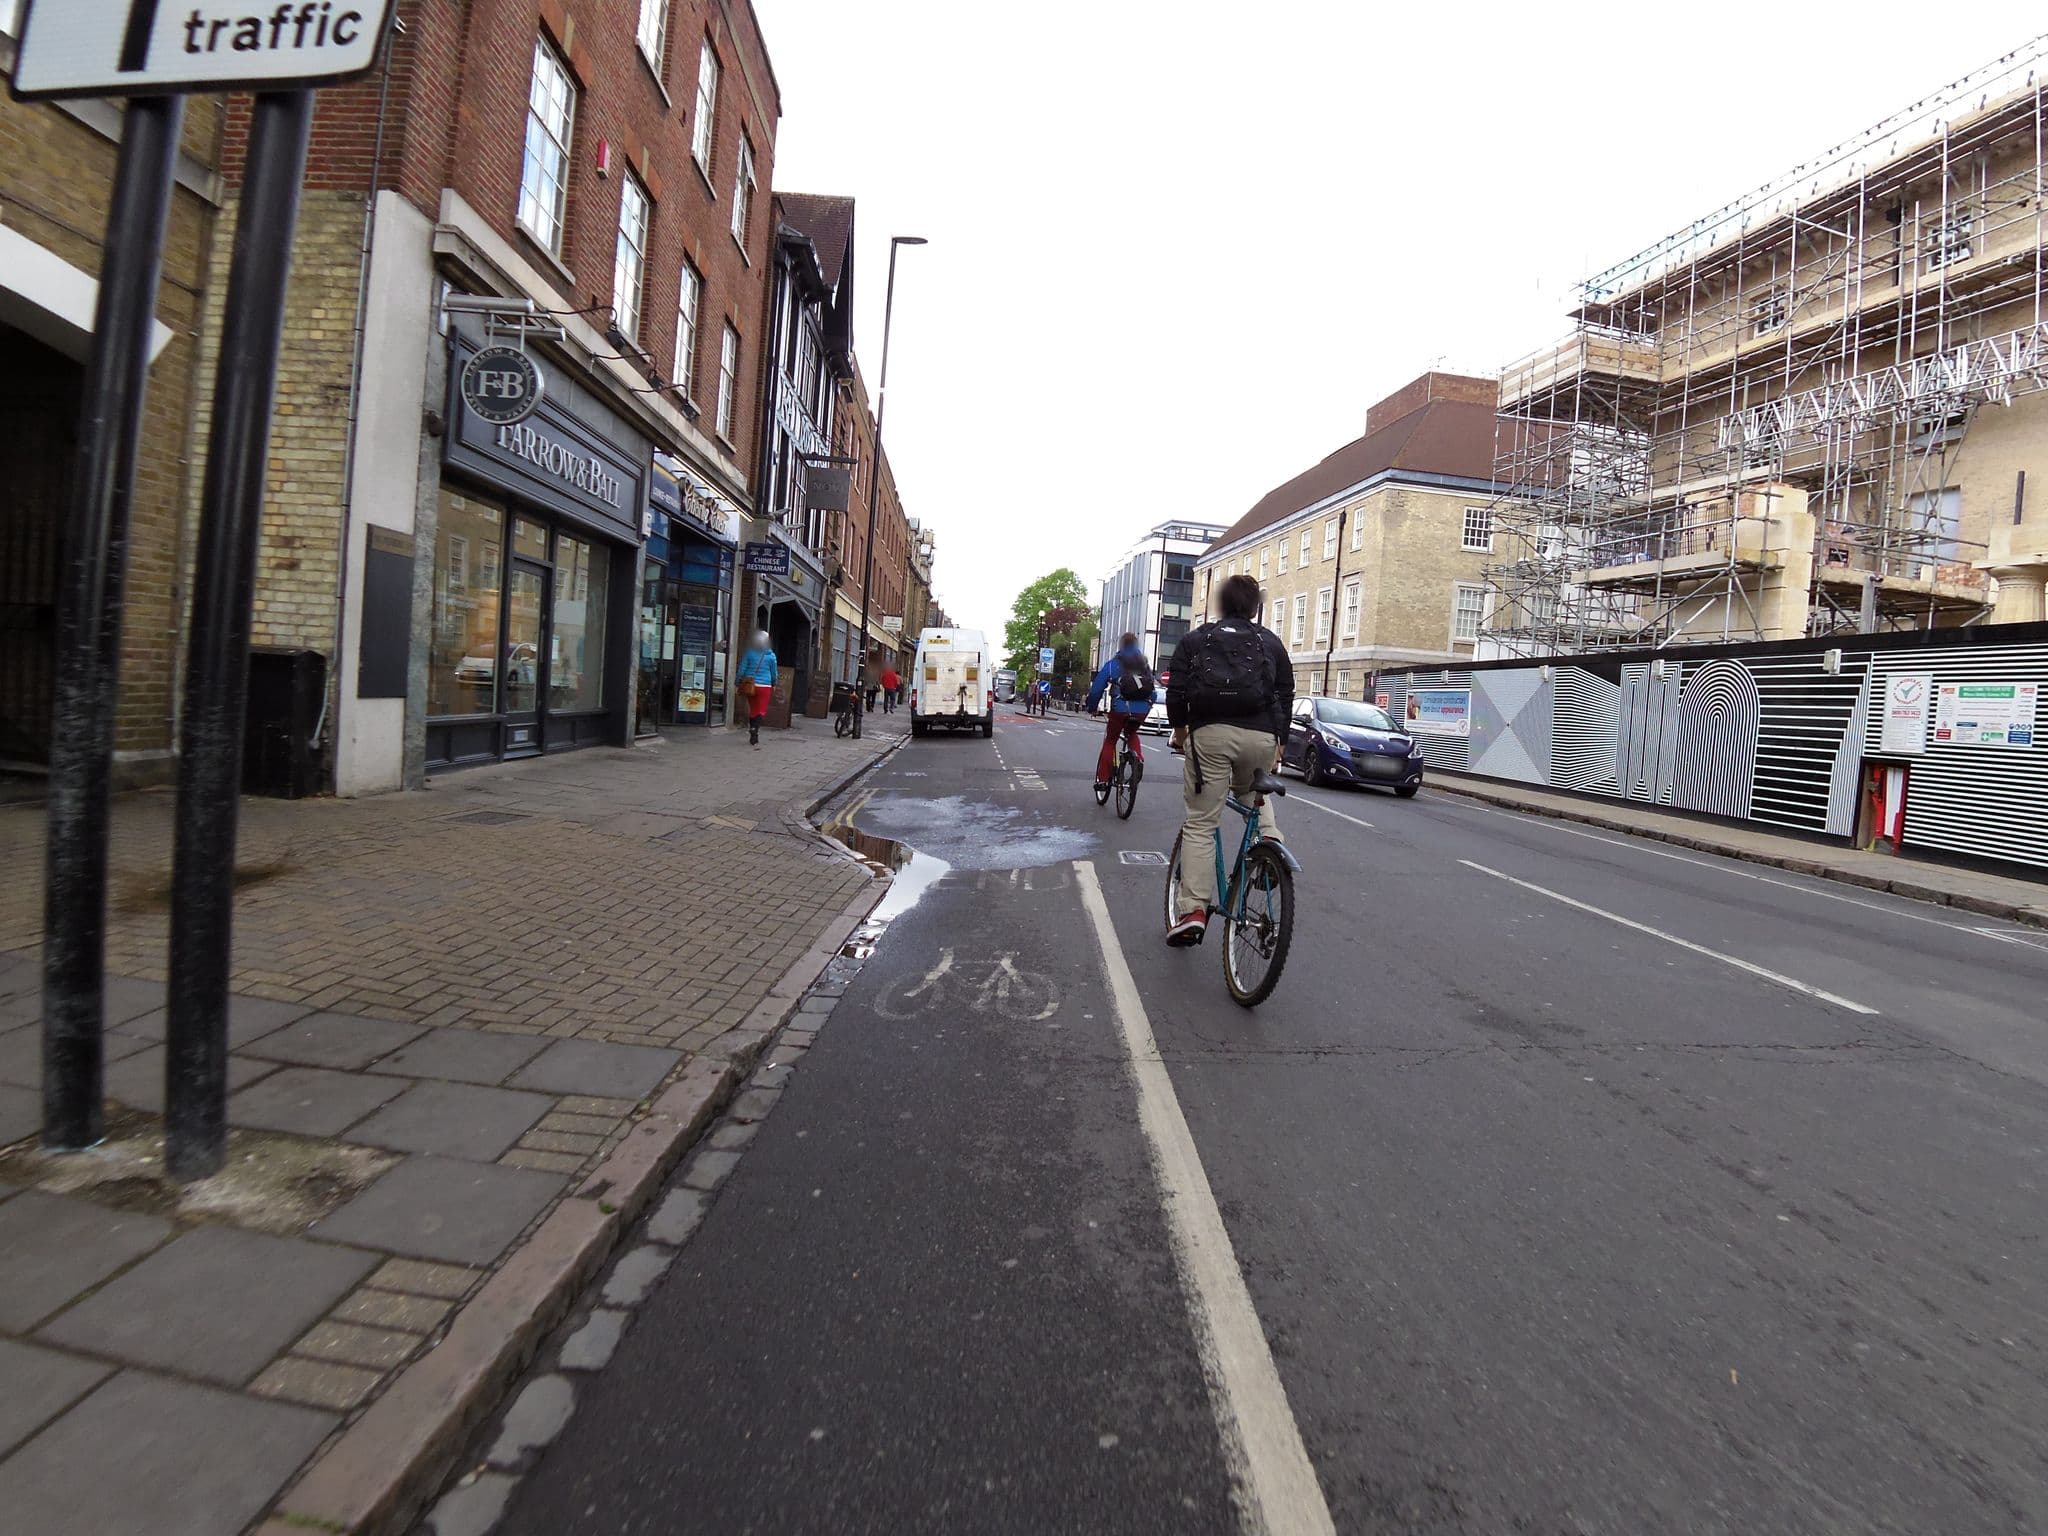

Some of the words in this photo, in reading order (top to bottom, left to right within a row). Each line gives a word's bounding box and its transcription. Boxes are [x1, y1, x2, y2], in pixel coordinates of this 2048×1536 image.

[183, 1, 362, 54] traffic
[753, 557, 781, 566] CHINESE
[746, 563, 787, 573] RESTAURANT
